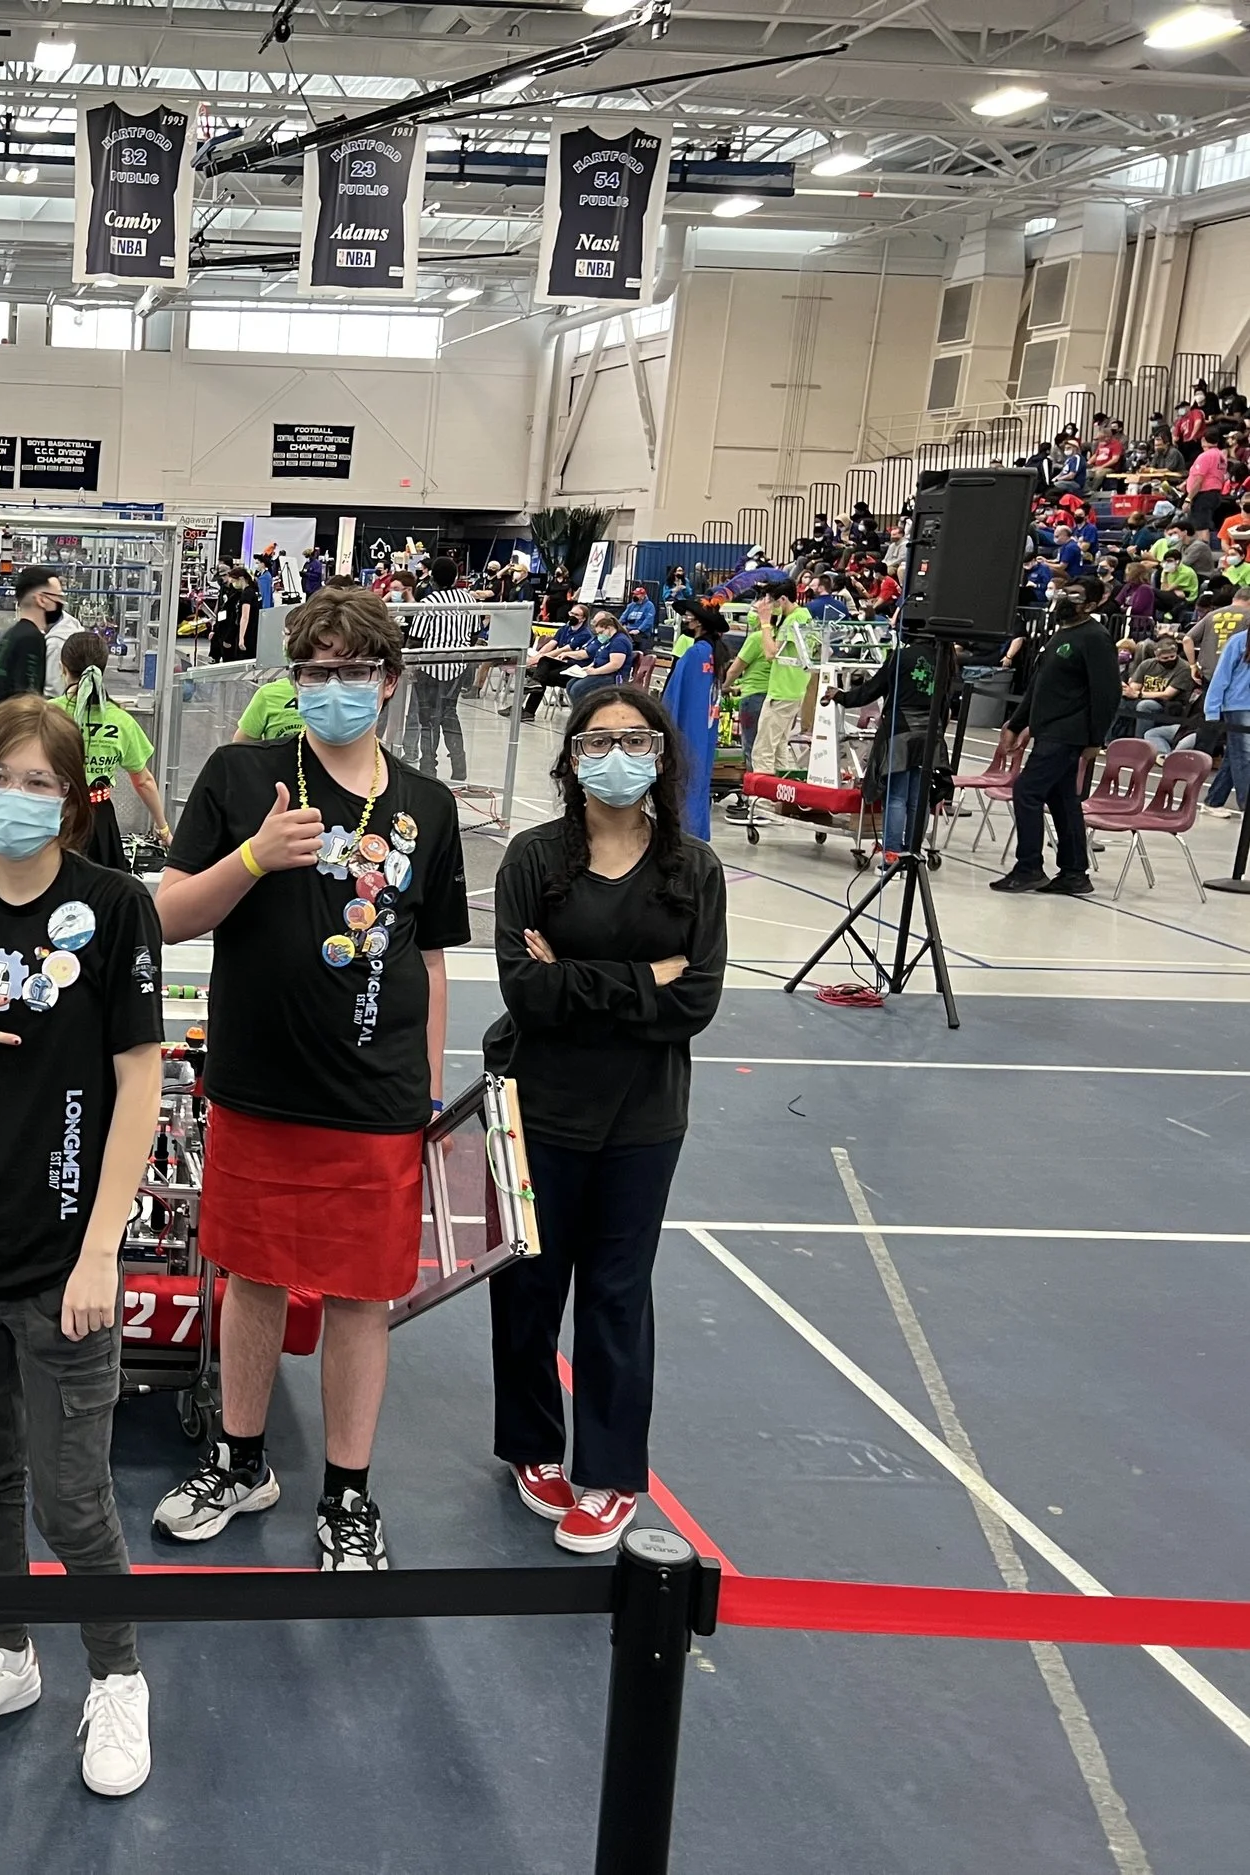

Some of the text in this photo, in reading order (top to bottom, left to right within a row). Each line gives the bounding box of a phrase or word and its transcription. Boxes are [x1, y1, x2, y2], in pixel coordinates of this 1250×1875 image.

[162, 115, 184, 126] 1993
[101, 127, 172, 152] HARTFORD
[391, 127, 414, 137] 1981
[330, 139, 402, 163] HARTFORD
[634, 138, 658, 149] 1968
[121, 148, 147, 166] 32
[572, 151, 644, 174] HARTFORD
[350, 160, 376, 178] 23
[110, 170, 160, 185] PUBLIC
[594, 172, 620, 188] 54
[338, 184, 389, 196] PUBLIC
[579, 195, 629, 207] PUBLIC
[104, 209, 161, 234] Camby
[329, 223, 390, 241] Adams
[117, 240, 142, 255] NBA
[575, 233, 620, 252] Nash
[346, 251, 371, 266] NBA
[586, 261, 611, 276] NBA
[48, 440, 94, 449] BASKETBALL
[290, 443, 336, 452] CHAMPIONS
[37, 456, 83, 465] CHAMPIONS
[58, 449, 86, 457] DIVISION
[180, 515, 214, 525] Agawam
[81, 723, 119, 739] 72
[358, 959, 383, 1046] ONGMETAL
[60, 1089, 83, 1220] LONGMETAL
[49, 1151, 61, 1190] EST. 2017
[122, 1290, 199, 1343] 27
